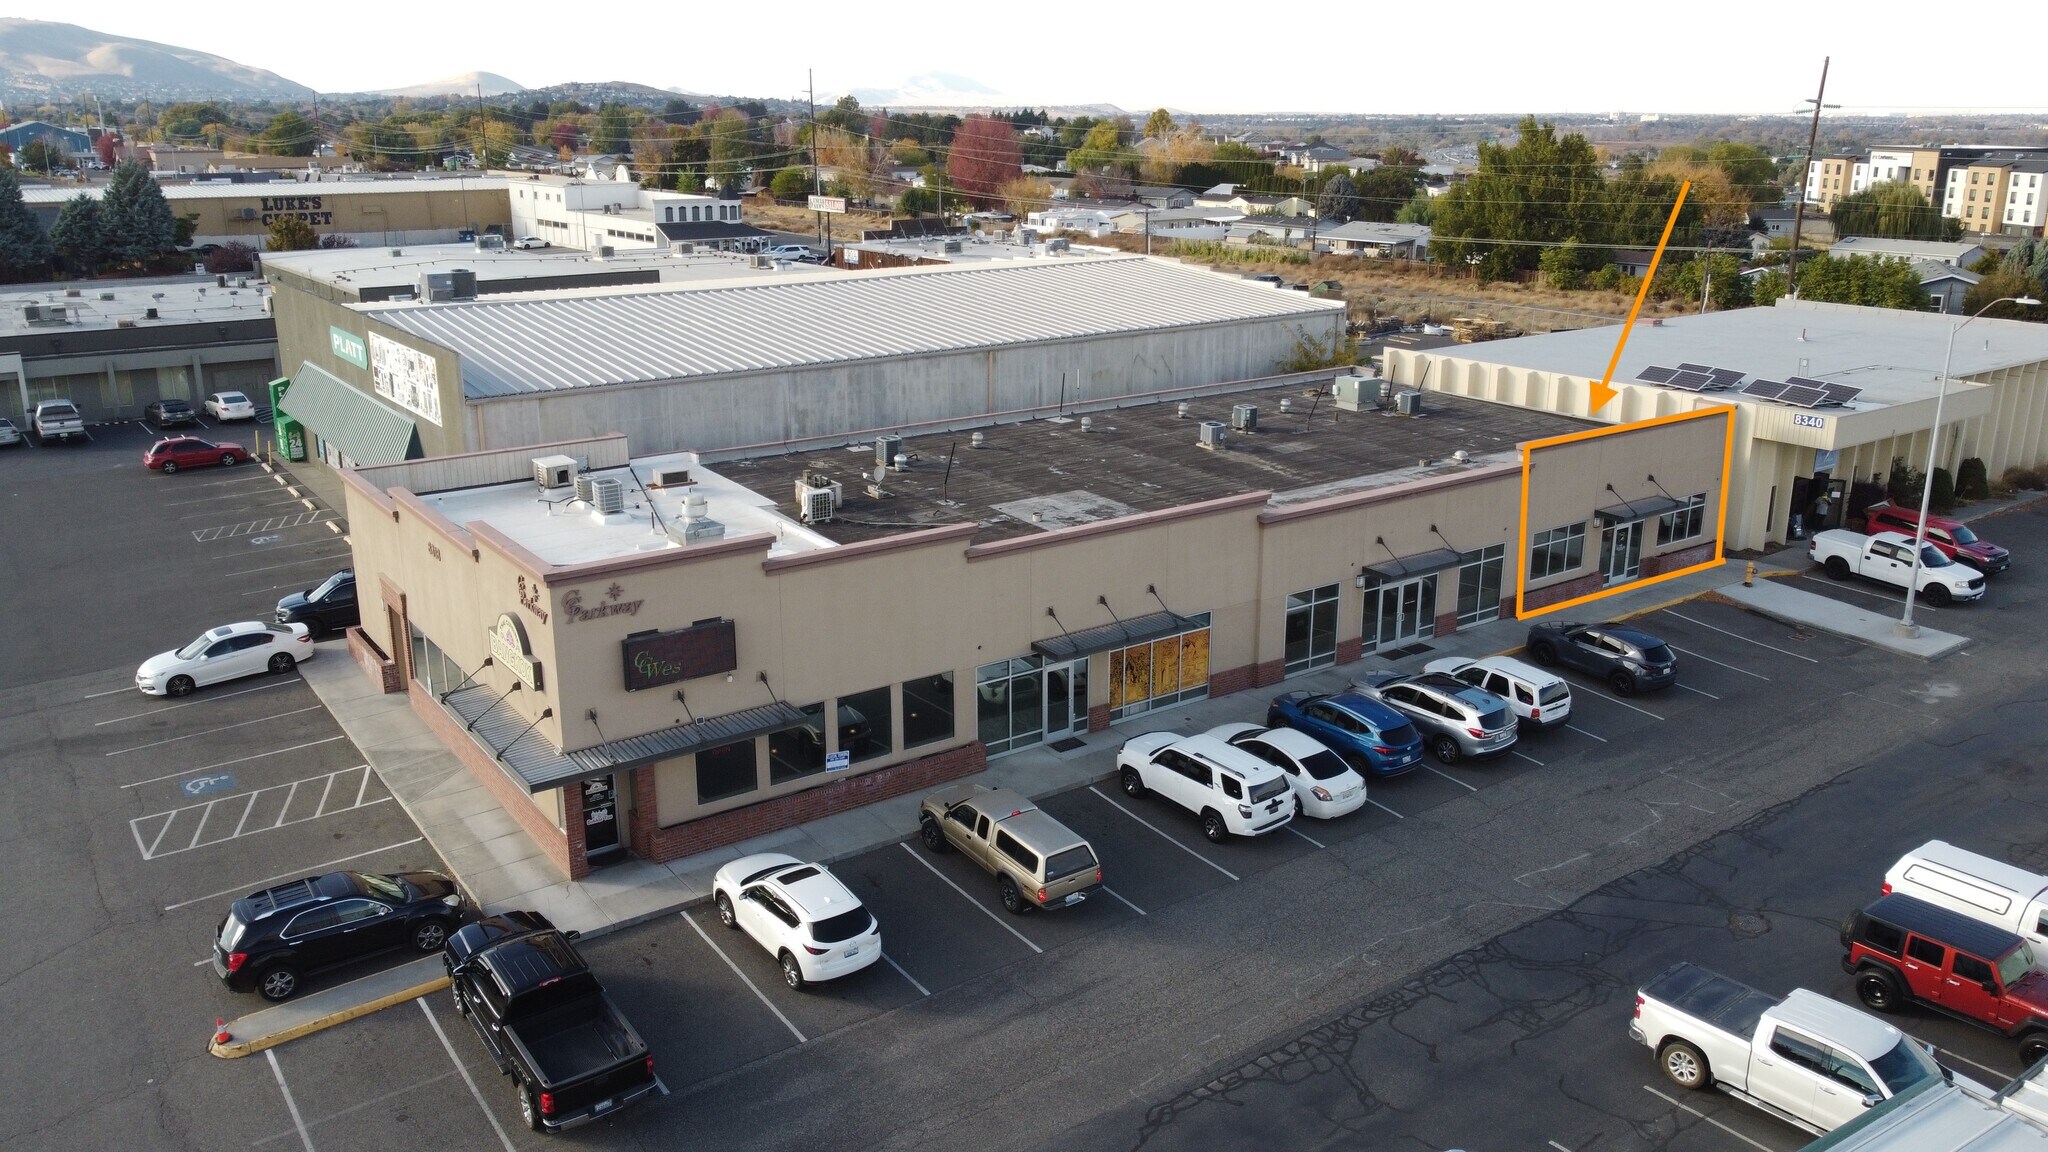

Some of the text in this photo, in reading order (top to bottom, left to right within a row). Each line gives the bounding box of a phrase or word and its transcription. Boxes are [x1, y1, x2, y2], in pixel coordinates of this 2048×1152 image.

[261, 196, 322, 211] LUKE'S
[262, 212, 332, 227] CPET
[333, 333, 363, 361] PLATT
[1794, 414, 1823, 428] 8340
[566, 599, 645, 624] Parkway
[490, 633, 534, 686] BANGKOK
